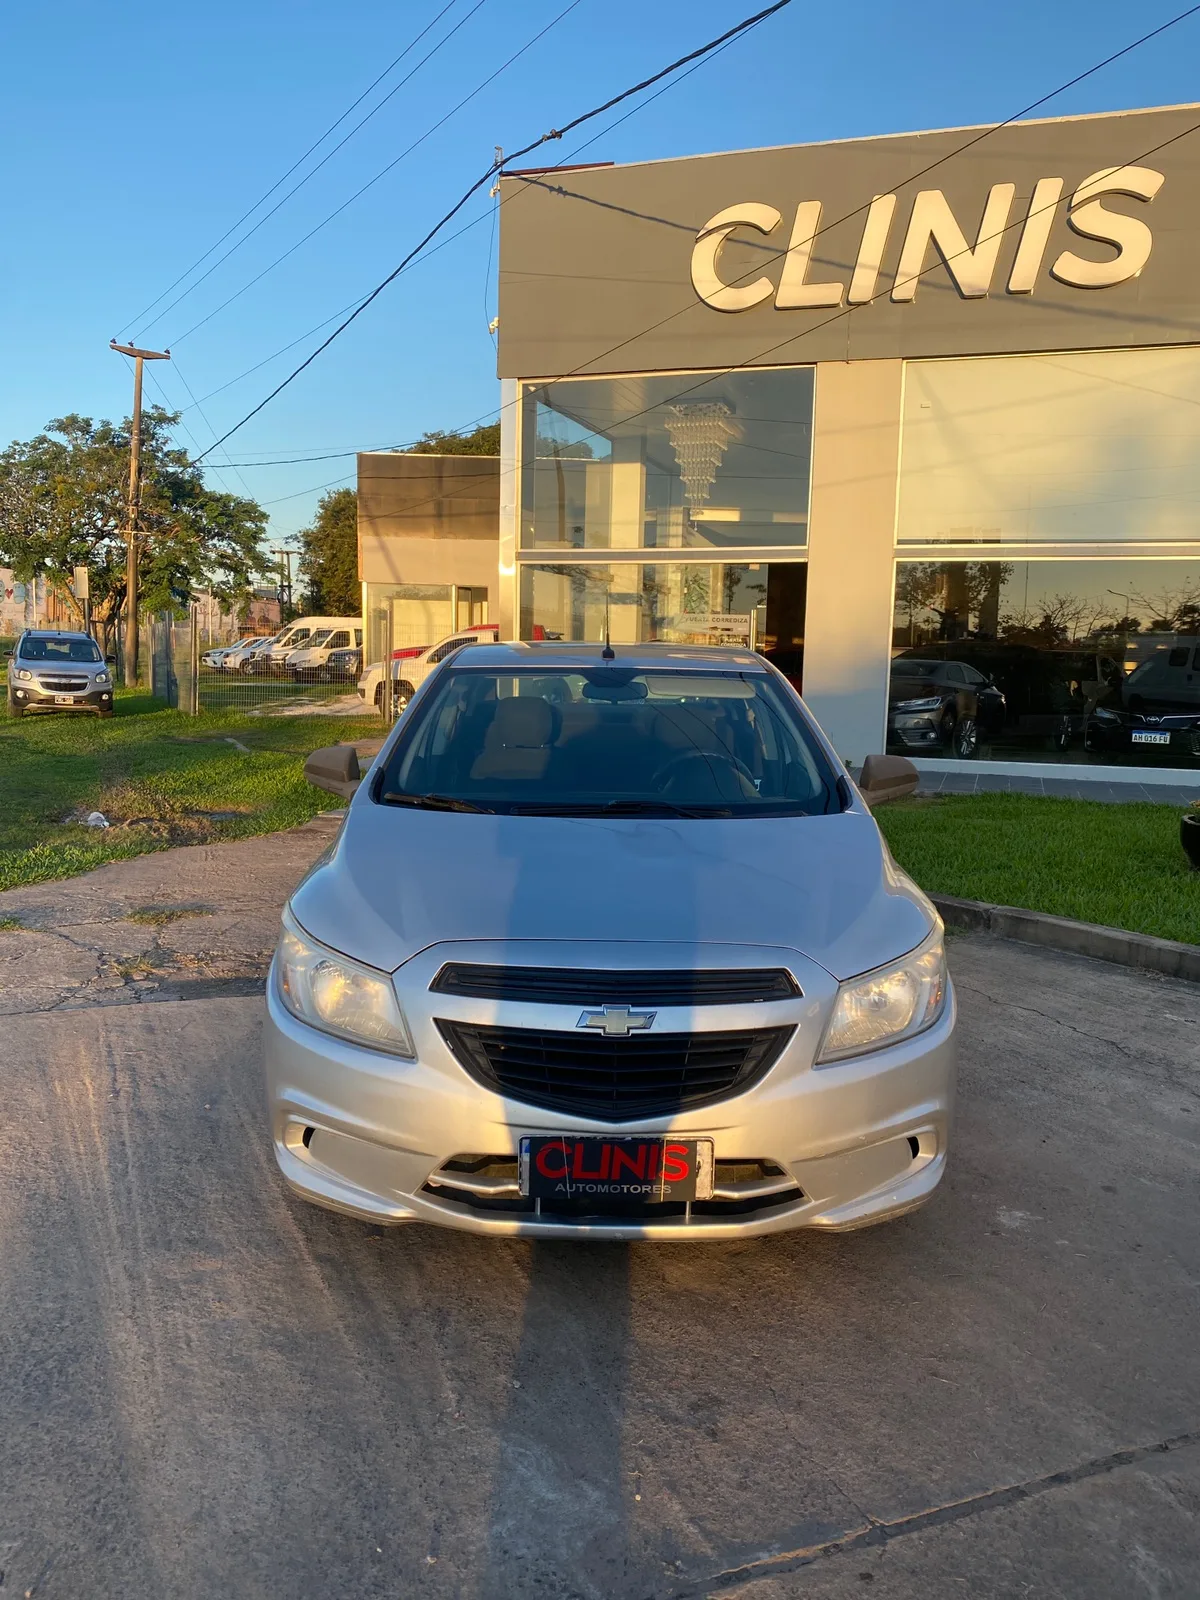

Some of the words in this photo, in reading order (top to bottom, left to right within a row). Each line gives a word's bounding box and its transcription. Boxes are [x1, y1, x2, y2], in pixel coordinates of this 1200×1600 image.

[690, 165, 1166, 313] CLINIS
[535, 1141, 690, 1182] CLINIS
[555, 1183, 672, 1194] AUTOMOTORES
